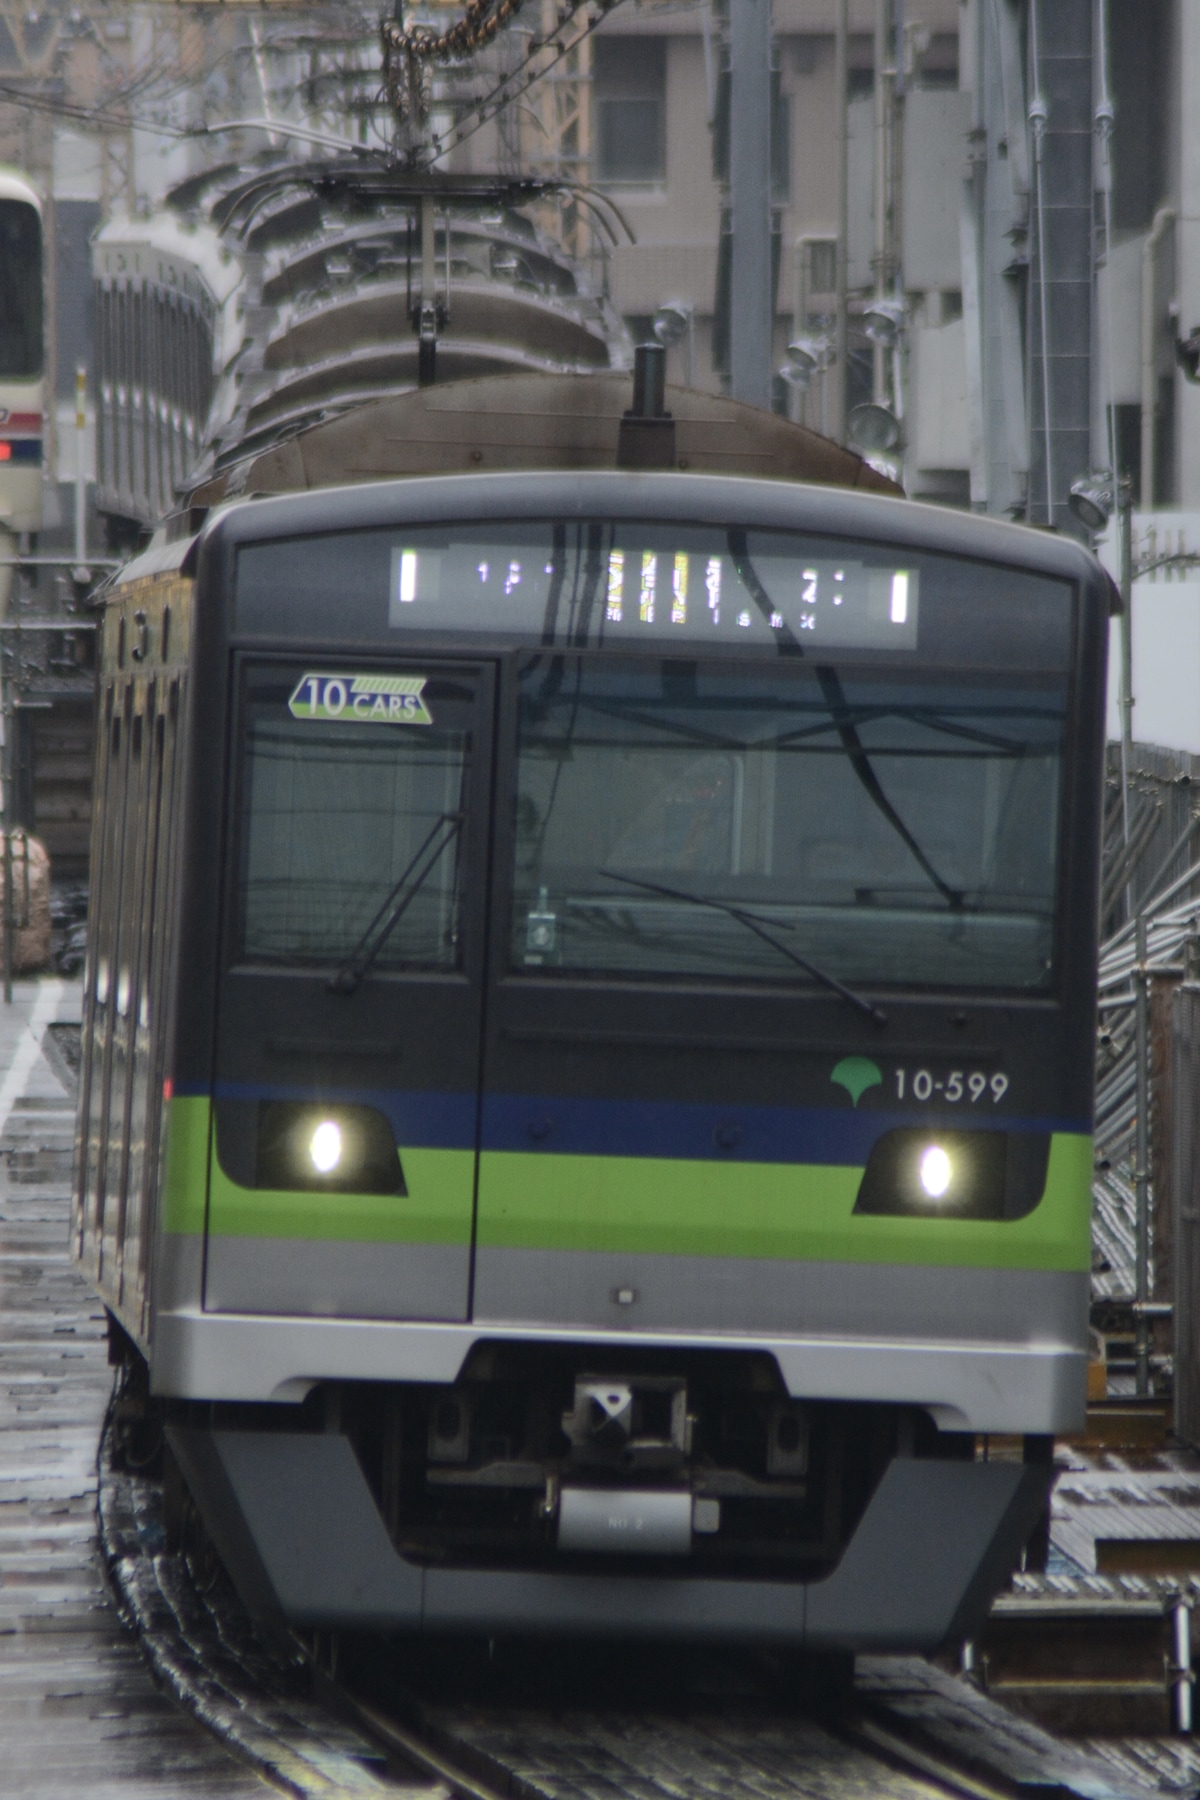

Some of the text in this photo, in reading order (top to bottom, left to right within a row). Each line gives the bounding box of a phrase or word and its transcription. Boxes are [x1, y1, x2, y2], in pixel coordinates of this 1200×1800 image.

[306, 678, 417, 719] 10 CARS
[896, 1068, 1009, 1104] 10-599
